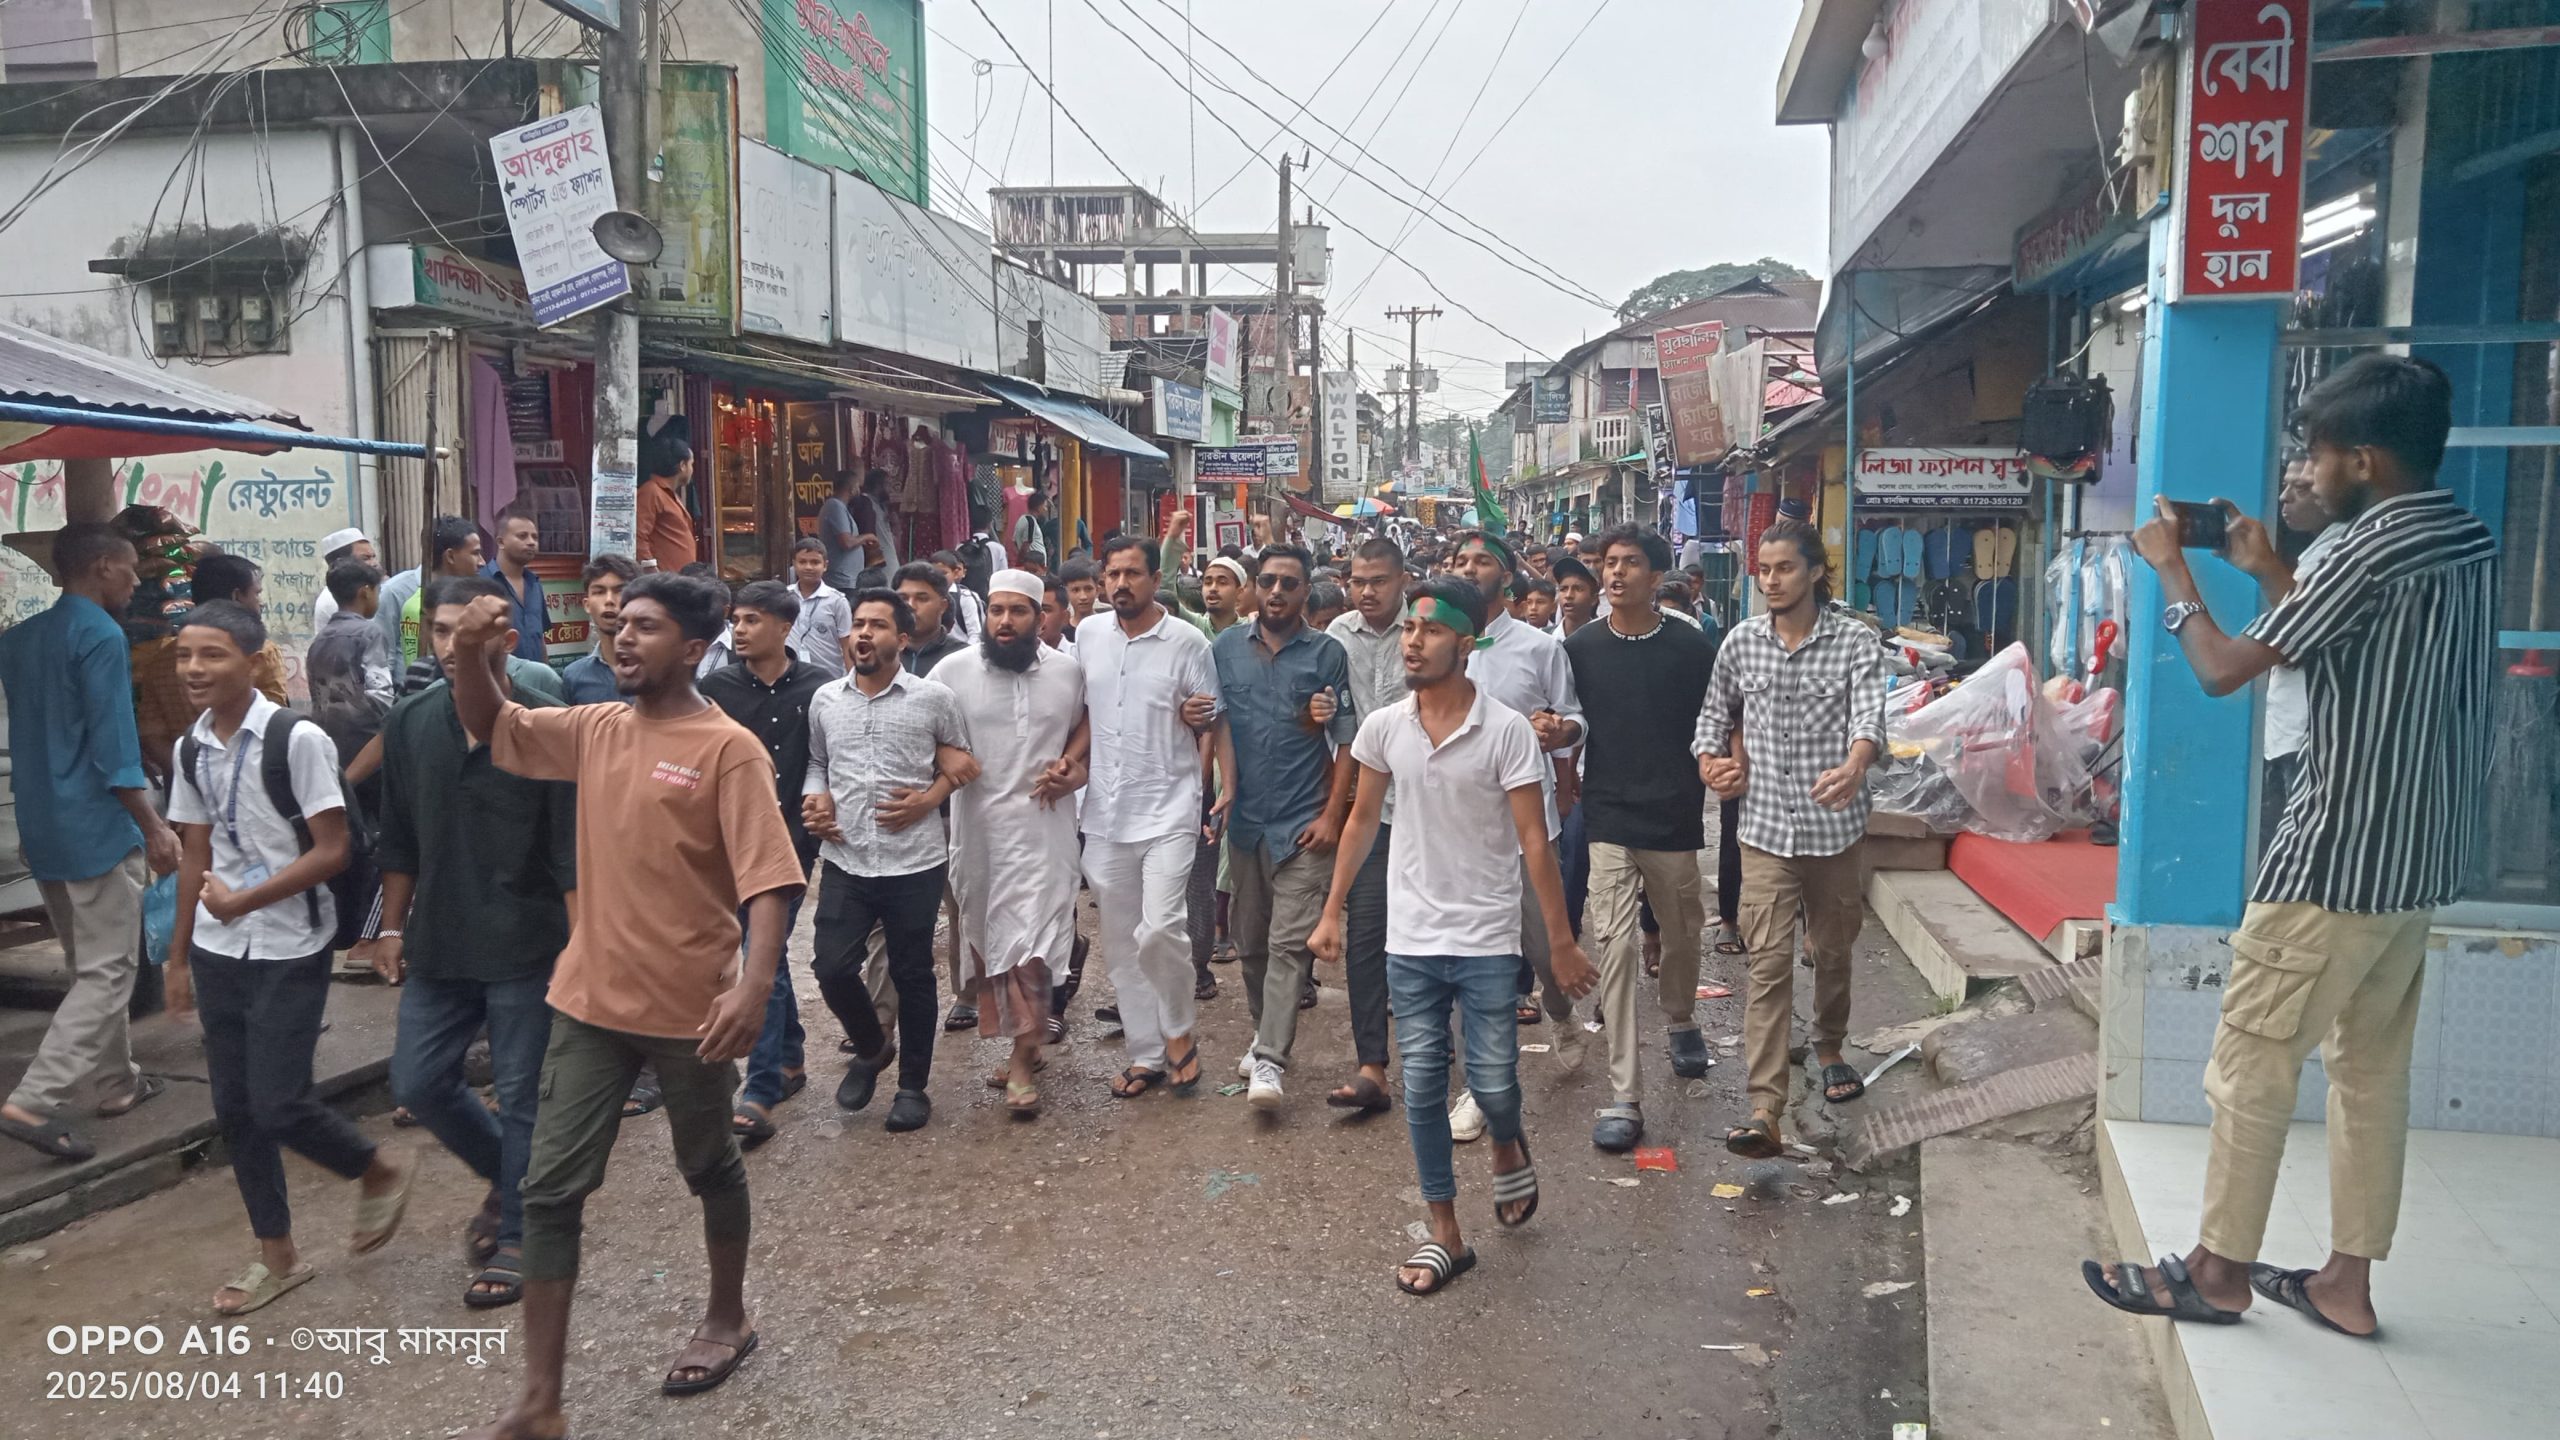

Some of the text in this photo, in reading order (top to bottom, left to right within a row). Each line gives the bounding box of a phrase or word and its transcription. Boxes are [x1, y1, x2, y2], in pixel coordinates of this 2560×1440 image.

[2201, 3, 2295, 97] বেবী
[501, 129, 600, 179] আব্দুল্লাহ
[2197, 119, 2289, 180] শপ
[510, 168, 604, 220] স্পোর্টস এন্ড ফ্যাশন
[2208, 193, 2271, 239] দুল
[424, 254, 482, 296] খাদিজা
[2201, 250, 2272, 288] হান
[797, 440, 825, 467] আল
[1328, 393, 1349, 480] WALTON
[1861, 451, 1913, 475] লিজা
[1918, 457, 1985, 477] ফ্যাশন
[228, 466, 335, 518] রেষ্টুরেন্ট
[795, 473, 834, 505] আমিন
[270, 538, 316, 558] আছে
[558, 622, 583, 642] ষ্টোর
[651, 770, 697, 790] NOT HEARTS
[656, 760, 701, 780] BREAK RULES
